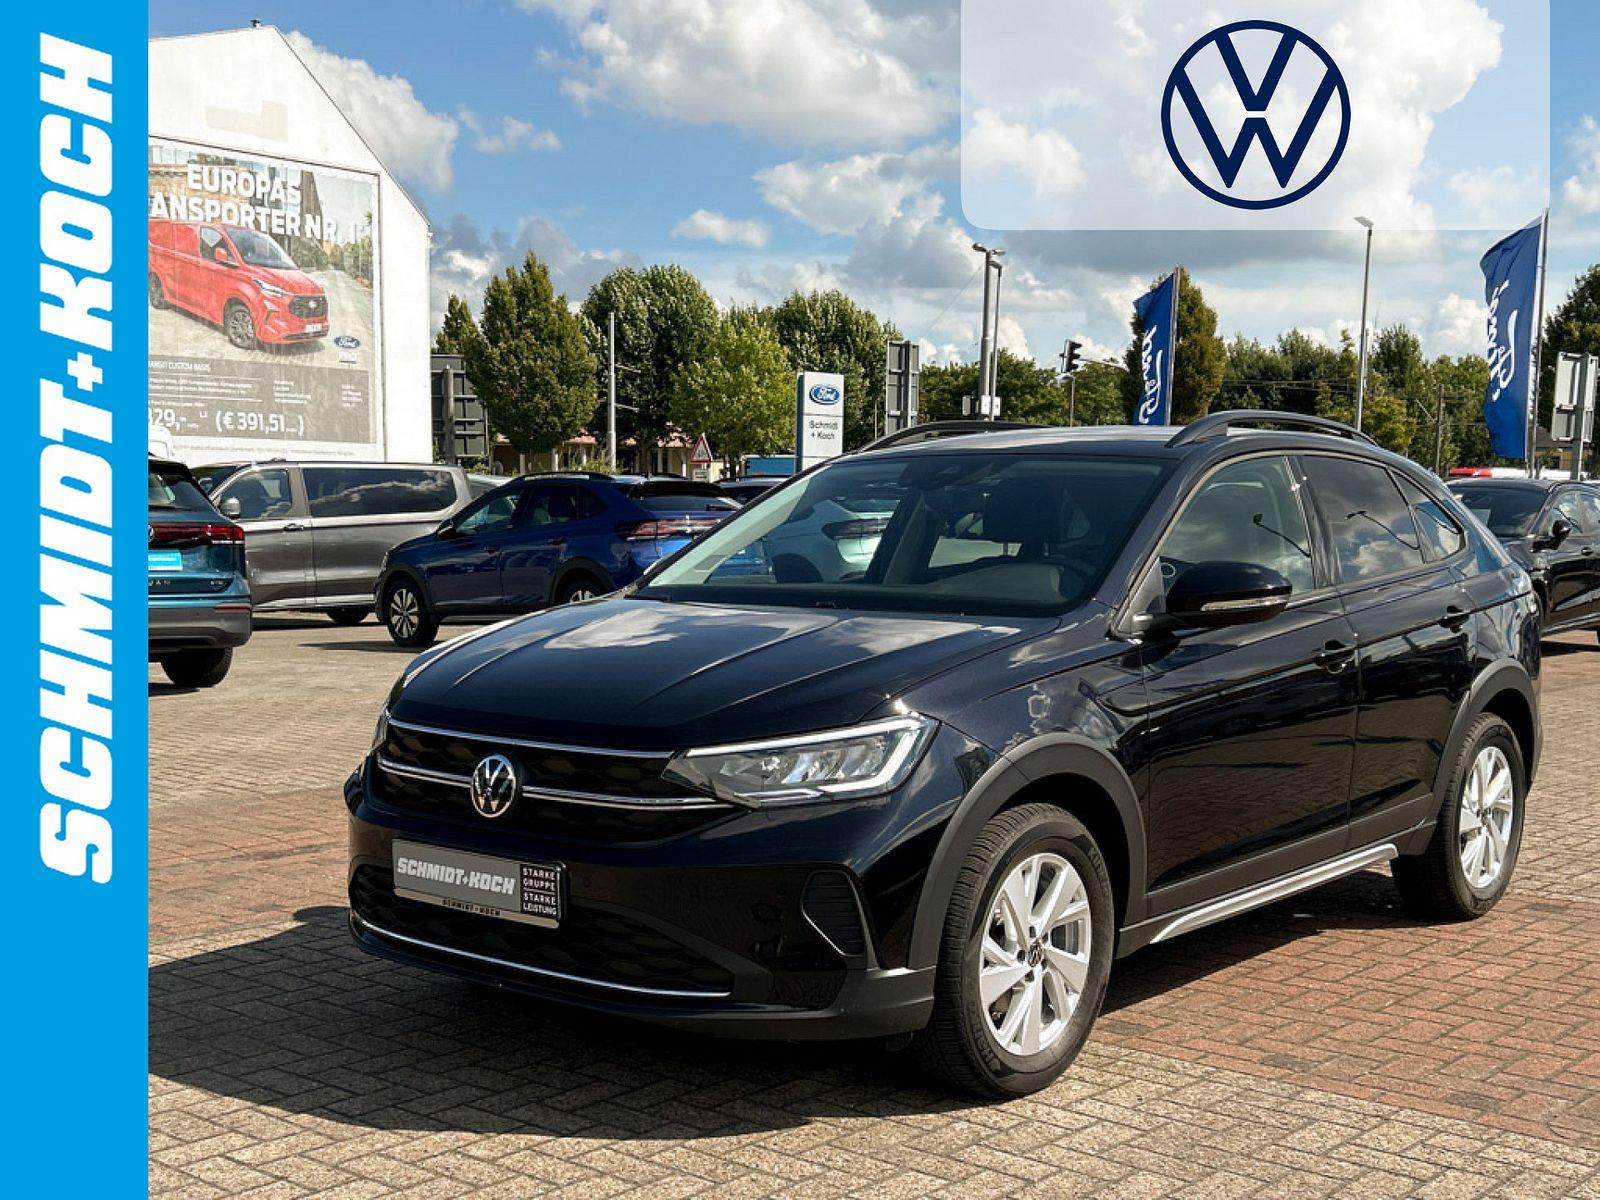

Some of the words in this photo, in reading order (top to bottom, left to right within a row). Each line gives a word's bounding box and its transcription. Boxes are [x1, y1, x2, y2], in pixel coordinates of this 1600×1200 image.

[187, 163, 301, 206] EUROPAS
[149, 191, 301, 236] ANSPORTER
[809, 420, 838, 431] Schmidt
[817, 432, 835, 440] Koch
[397, 857, 516, 895] SCHMIDT+KOCH
[523, 867, 555, 880] STARKE
[523, 878, 555, 891] GRUPPE
[523, 892, 556, 906] STARKE
[523, 902, 557, 915] LEISTUNG
